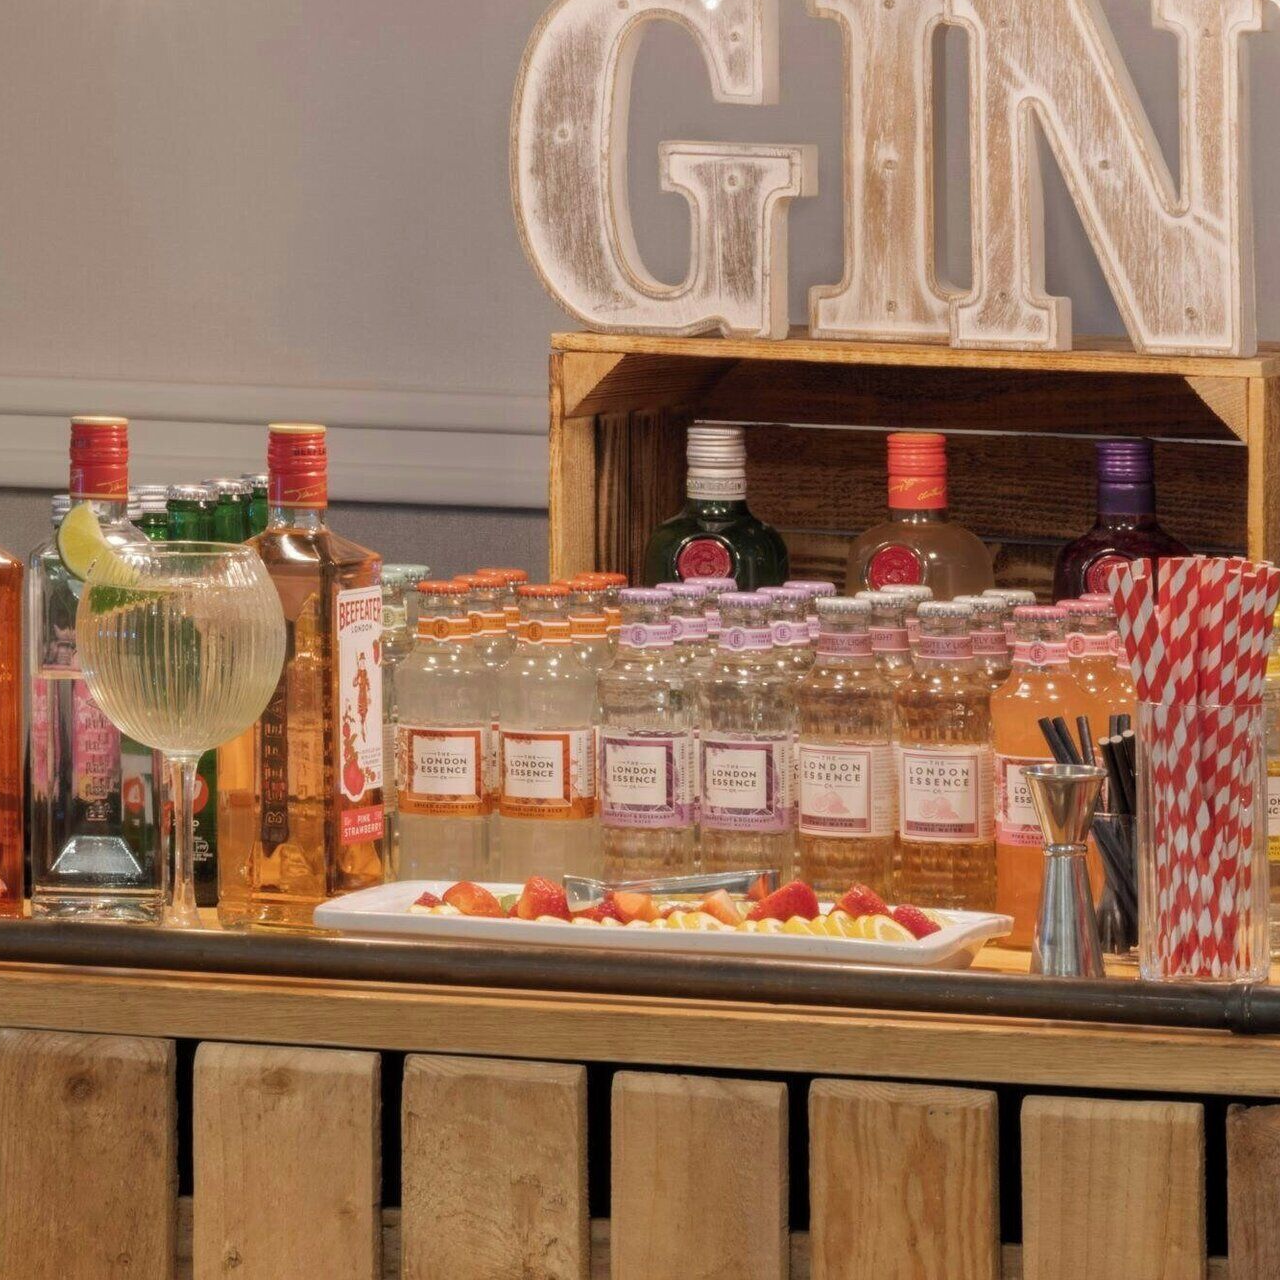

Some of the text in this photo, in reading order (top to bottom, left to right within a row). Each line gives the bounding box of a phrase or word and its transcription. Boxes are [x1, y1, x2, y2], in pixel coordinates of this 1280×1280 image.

[339, 596, 382, 631] BEEFEATER
[420, 757, 467, 765] LONDON
[510, 760, 554, 768] LONDON
[421, 766, 467, 774] ESSENCE
[612, 766, 657, 774] LONDON
[803, 761, 861, 771] LONDON
[510, 768, 554, 777] ESSENCE
[712, 770, 757, 778] LONDON
[909, 767, 969, 776] LONDON
[613, 775, 657, 783] ESSENCE
[804, 771, 861, 782] ESSENCE
[712, 778, 757, 787] ESSENCE
[909, 777, 969, 787] ESSENCE
[344, 822, 382, 838] STRAWBERRY
